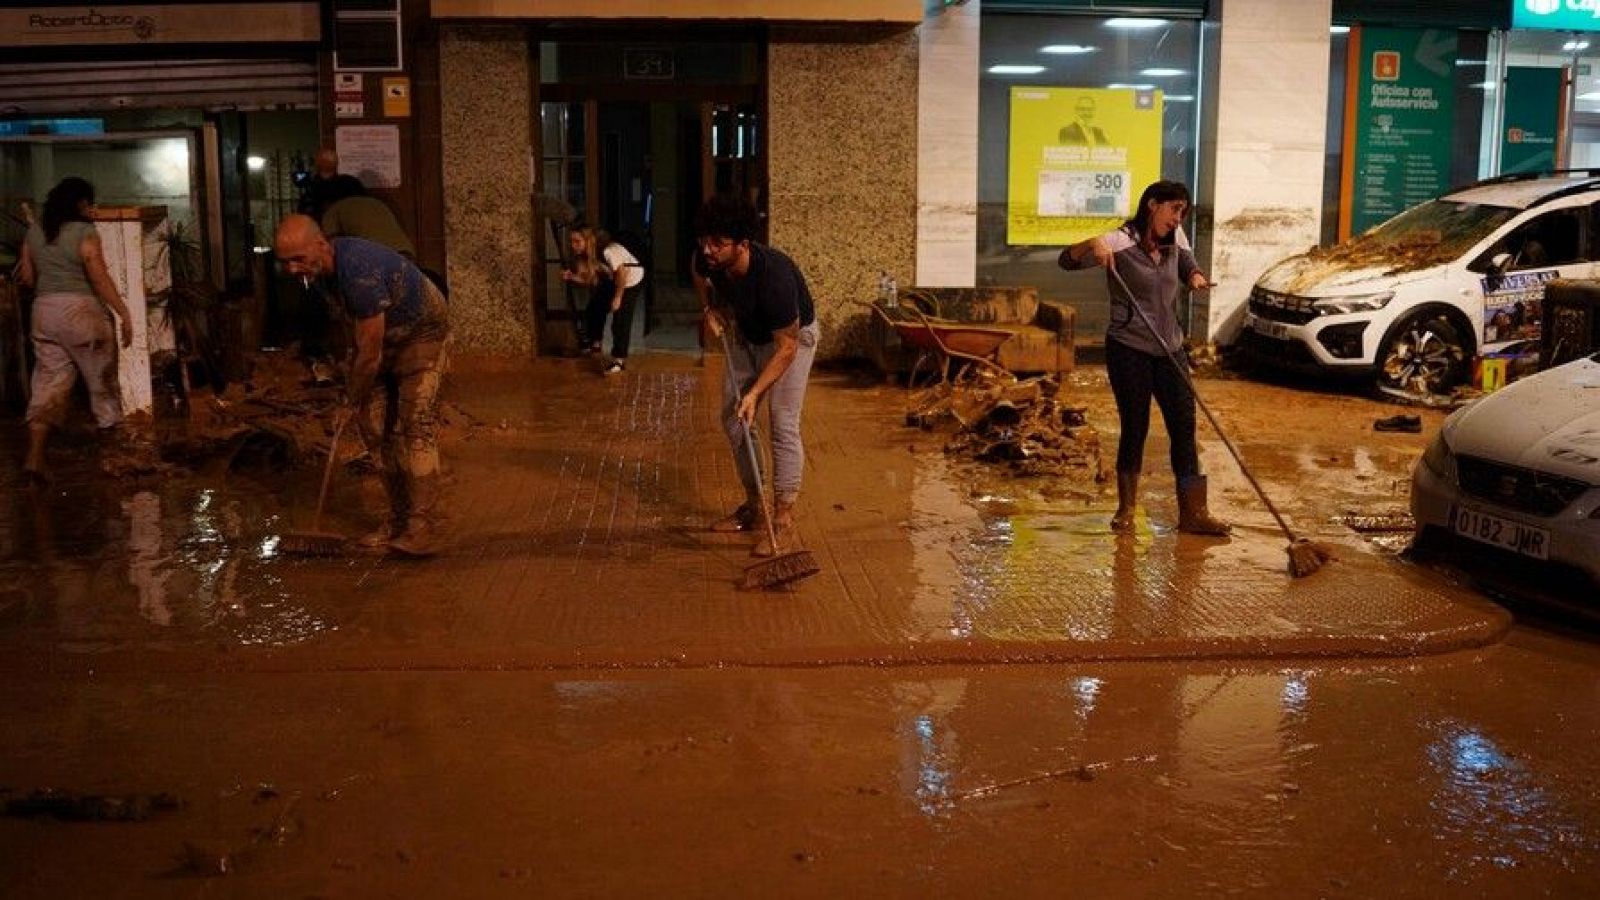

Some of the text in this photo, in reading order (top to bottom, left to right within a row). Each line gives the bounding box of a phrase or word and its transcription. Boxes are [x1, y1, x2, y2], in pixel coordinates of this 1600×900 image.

[1372, 83, 1433, 98] Oficina con
[1371, 96, 1440, 110] Autoservicio
[1094, 173, 1122, 189] 500
[1458, 510, 1503, 543] 0182
[1508, 525, 1546, 556] JMR
